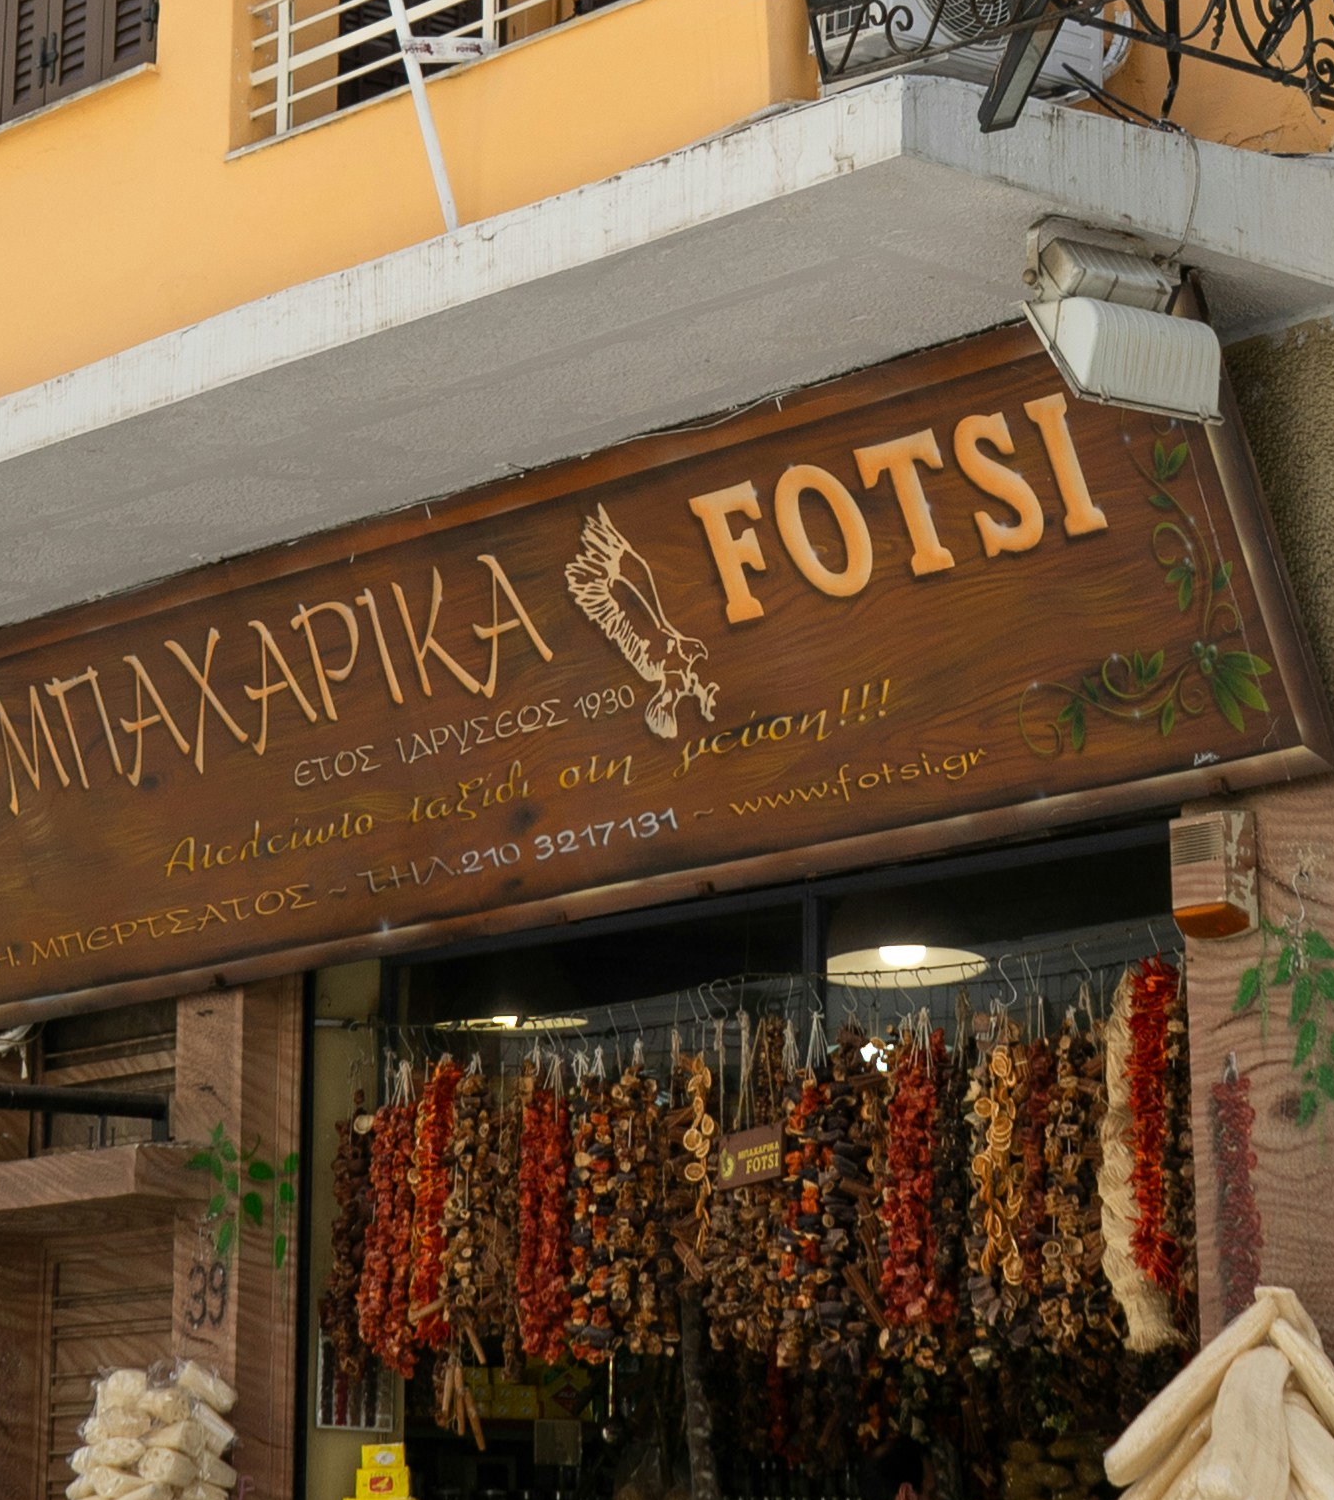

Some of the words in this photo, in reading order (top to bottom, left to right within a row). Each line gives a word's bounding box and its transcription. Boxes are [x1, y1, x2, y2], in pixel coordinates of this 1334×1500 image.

[688, 393, 1107, 625] FOTSI
[294, 745, 381, 787] ΕΤΟΣ
[574, 685, 635, 719] 1930
[31, 884, 317, 966] ΜΠΕΡΤΣΑΤΟΣ
[534, 807, 680, 862] 3217131
[729, 746, 987, 817] www.fotsi.gr
[746, 1152, 779, 1175] FOTSI
